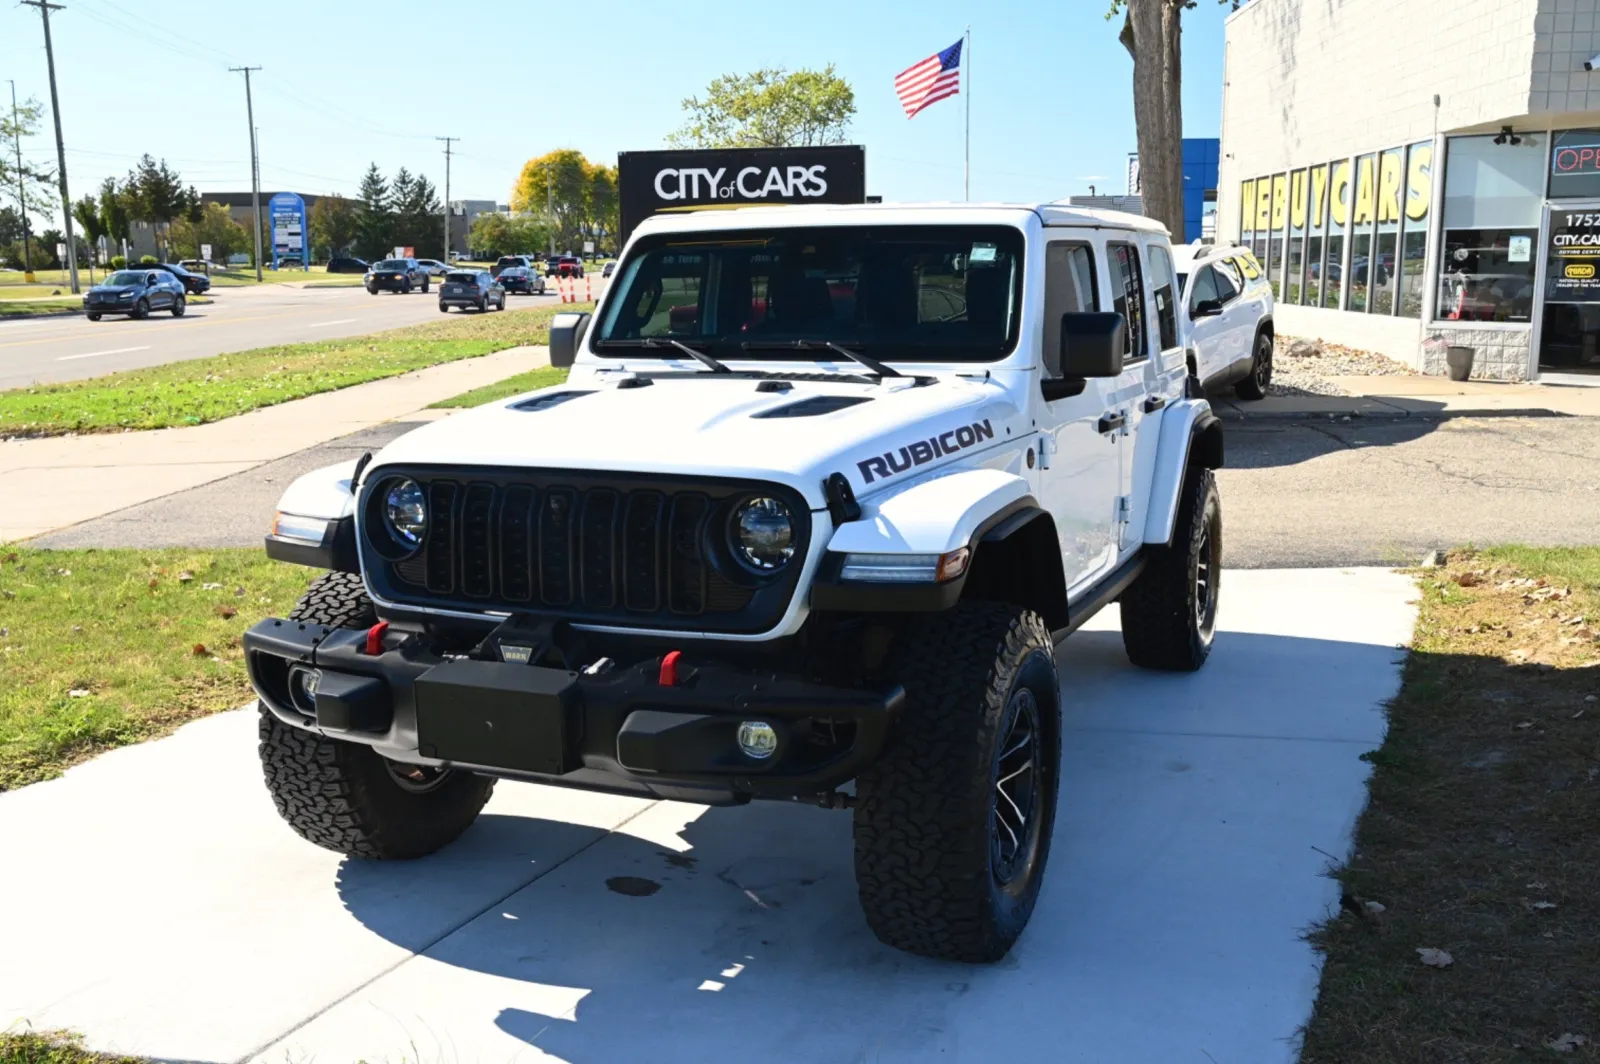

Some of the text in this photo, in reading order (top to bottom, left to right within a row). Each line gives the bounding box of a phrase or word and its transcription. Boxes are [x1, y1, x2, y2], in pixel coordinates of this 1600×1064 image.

[654, 165, 827, 200] CITY of CARS
[1553, 234, 1579, 246] CITY
[856, 418, 994, 485] RUBICON
[505, 651, 528, 661] WARN
